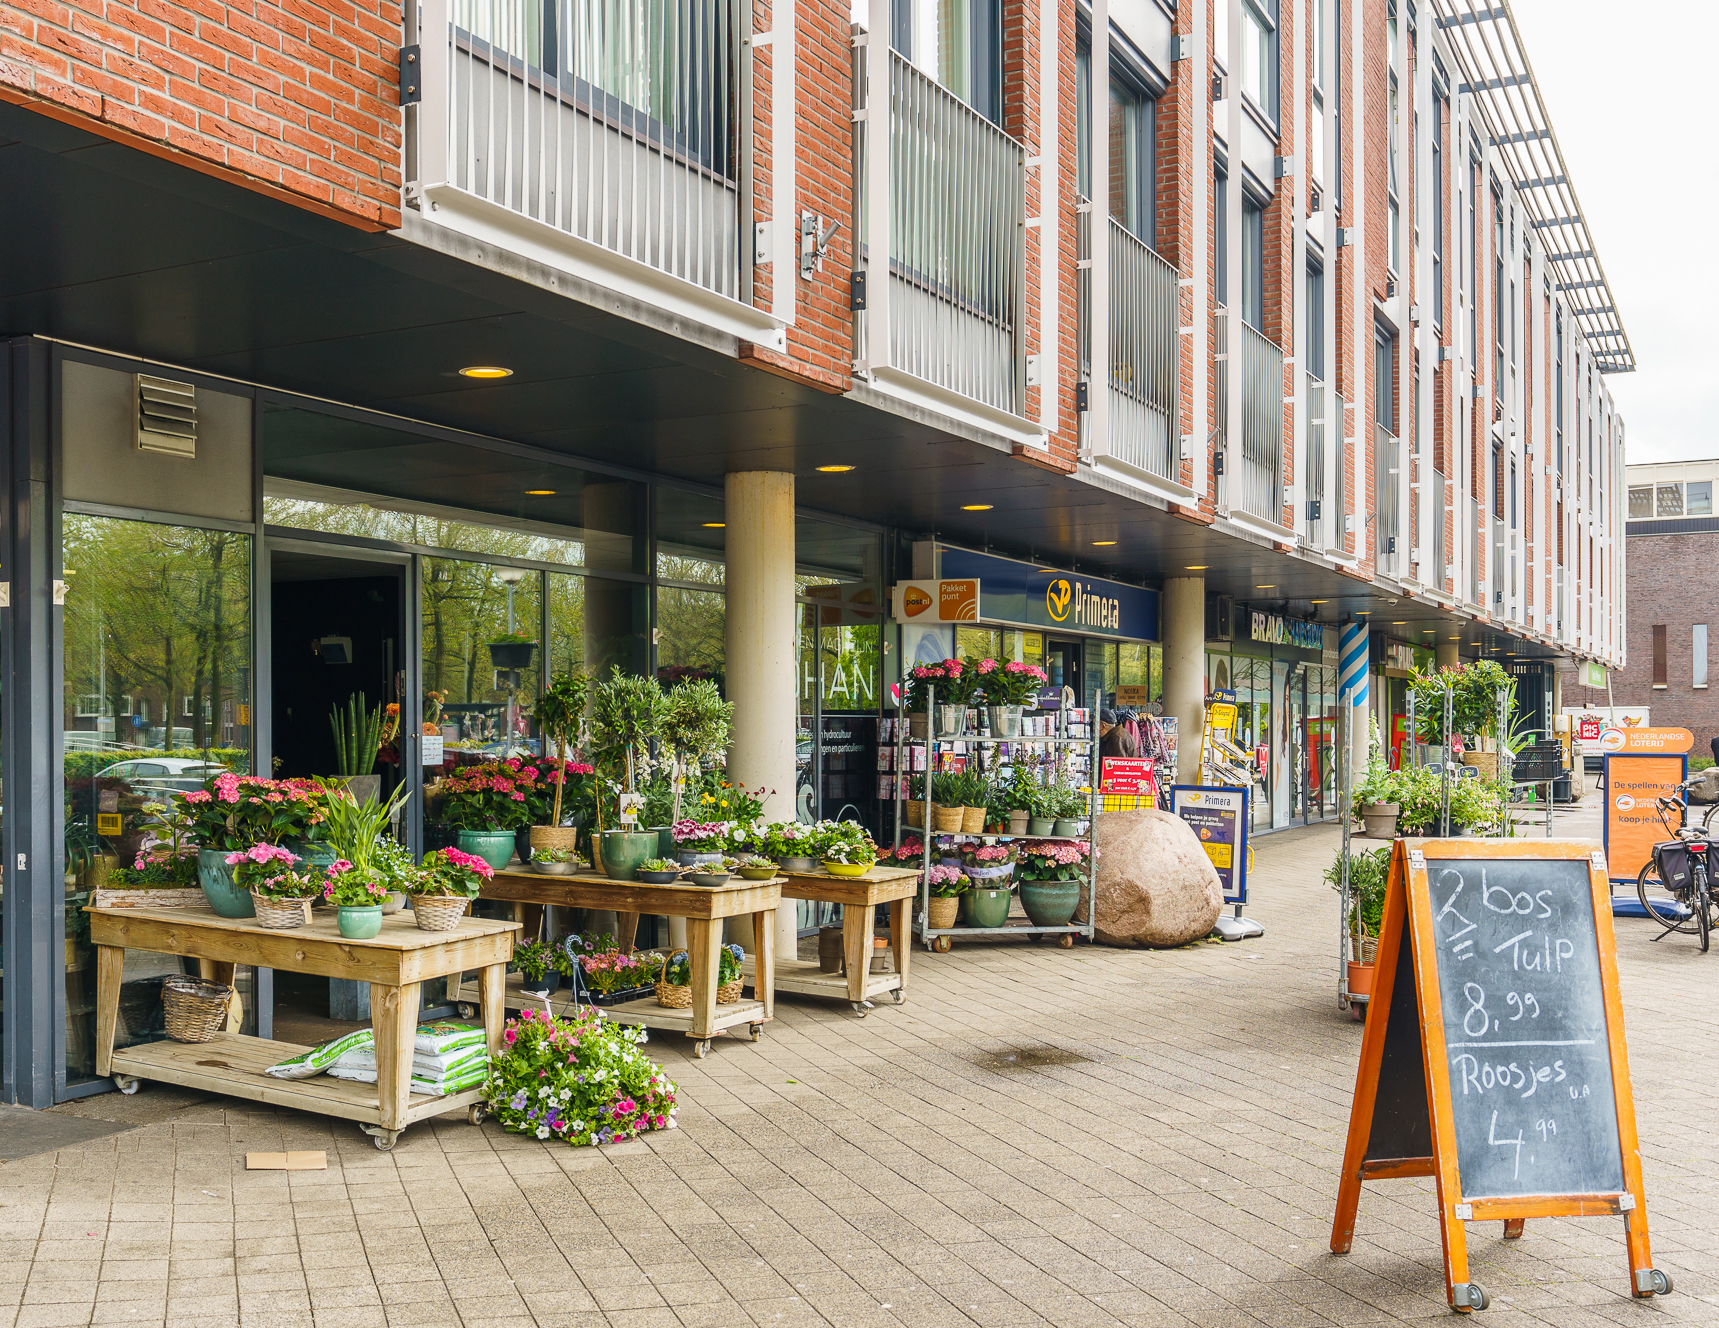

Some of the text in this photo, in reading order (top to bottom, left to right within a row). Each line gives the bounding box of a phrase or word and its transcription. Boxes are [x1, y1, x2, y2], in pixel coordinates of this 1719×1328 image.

[941, 584, 967, 592] Pakket
[906, 597, 930, 607] postnl
[941, 593, 960, 602] punt
[1075, 581, 1119, 630] Primera
[795, 660, 873, 701] HAN
[1627, 782, 1658, 790] spellen
[1205, 794, 1231, 806] Primera
[1619, 816, 1641, 824] koop
[1642, 816, 1650, 824] je
[1436, 868, 1478, 926] 2
[1482, 868, 1553, 919] bos
[1452, 1053, 1568, 1098] Roosjes
